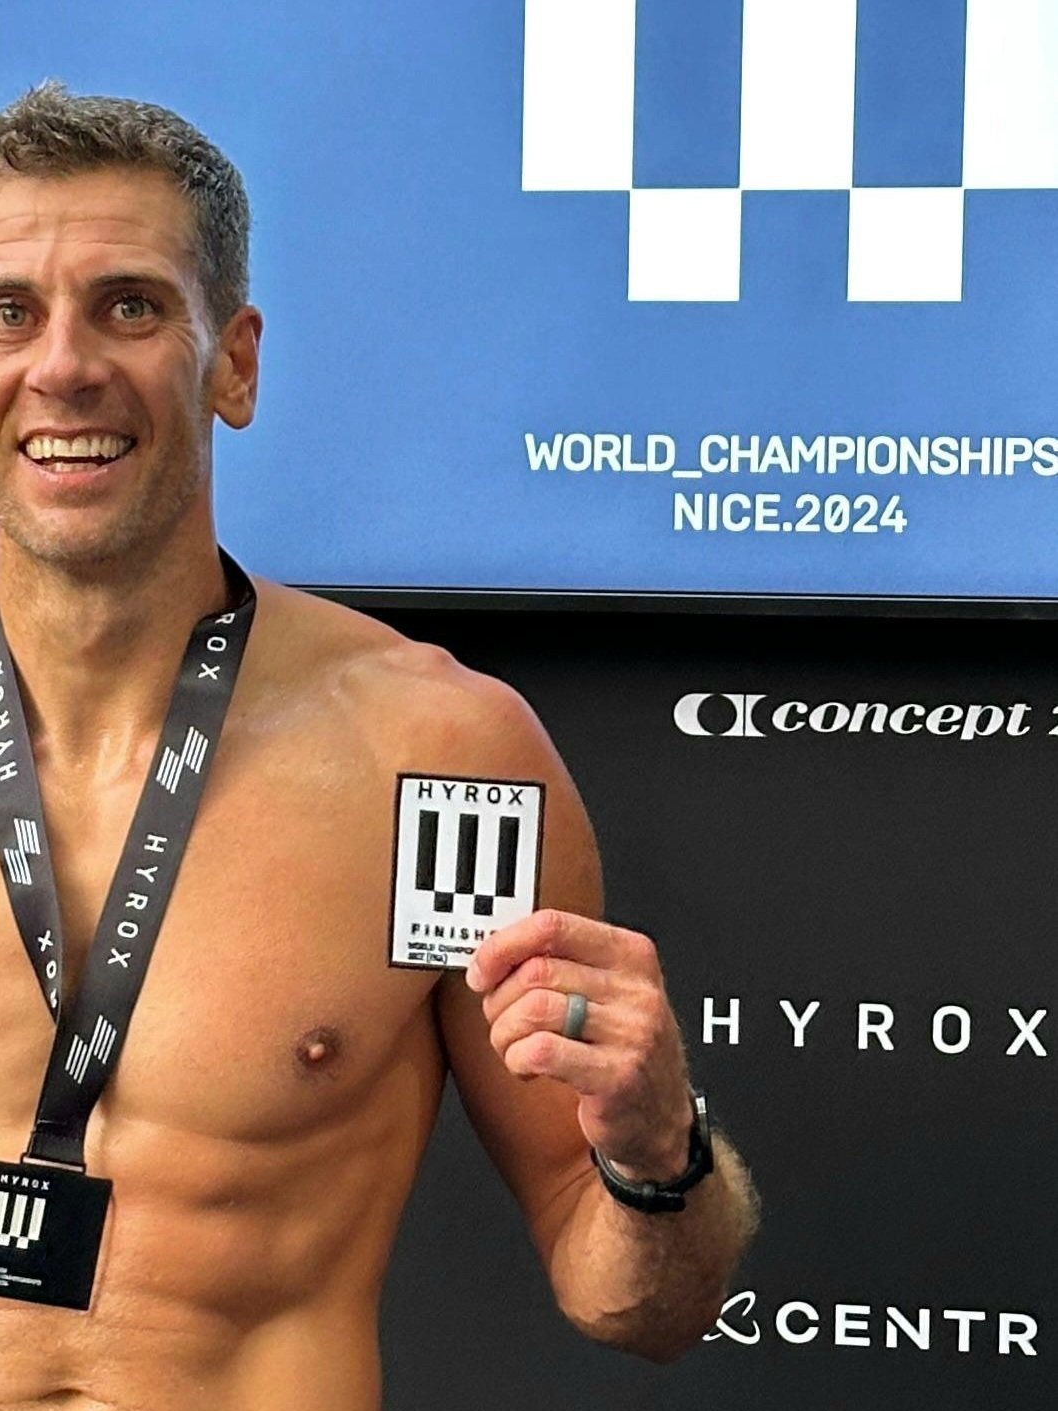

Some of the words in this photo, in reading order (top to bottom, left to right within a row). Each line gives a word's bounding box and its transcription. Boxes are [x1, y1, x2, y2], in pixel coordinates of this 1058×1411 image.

[525, 433, 1058, 478] WORLD_CHAMPIONSHIPS
[673, 493, 908, 533] NICE.2024
[771, 701, 1032, 741] concept
[417, 780, 524, 806] HYROX
[107, 833, 168, 970] HYROX
[411, 922, 498, 941] FINISH
[702, 997, 1047, 1057] HYROX
[0, 1174, 50, 1191] HYROX
[775, 1301, 1038, 1356] CENTR
